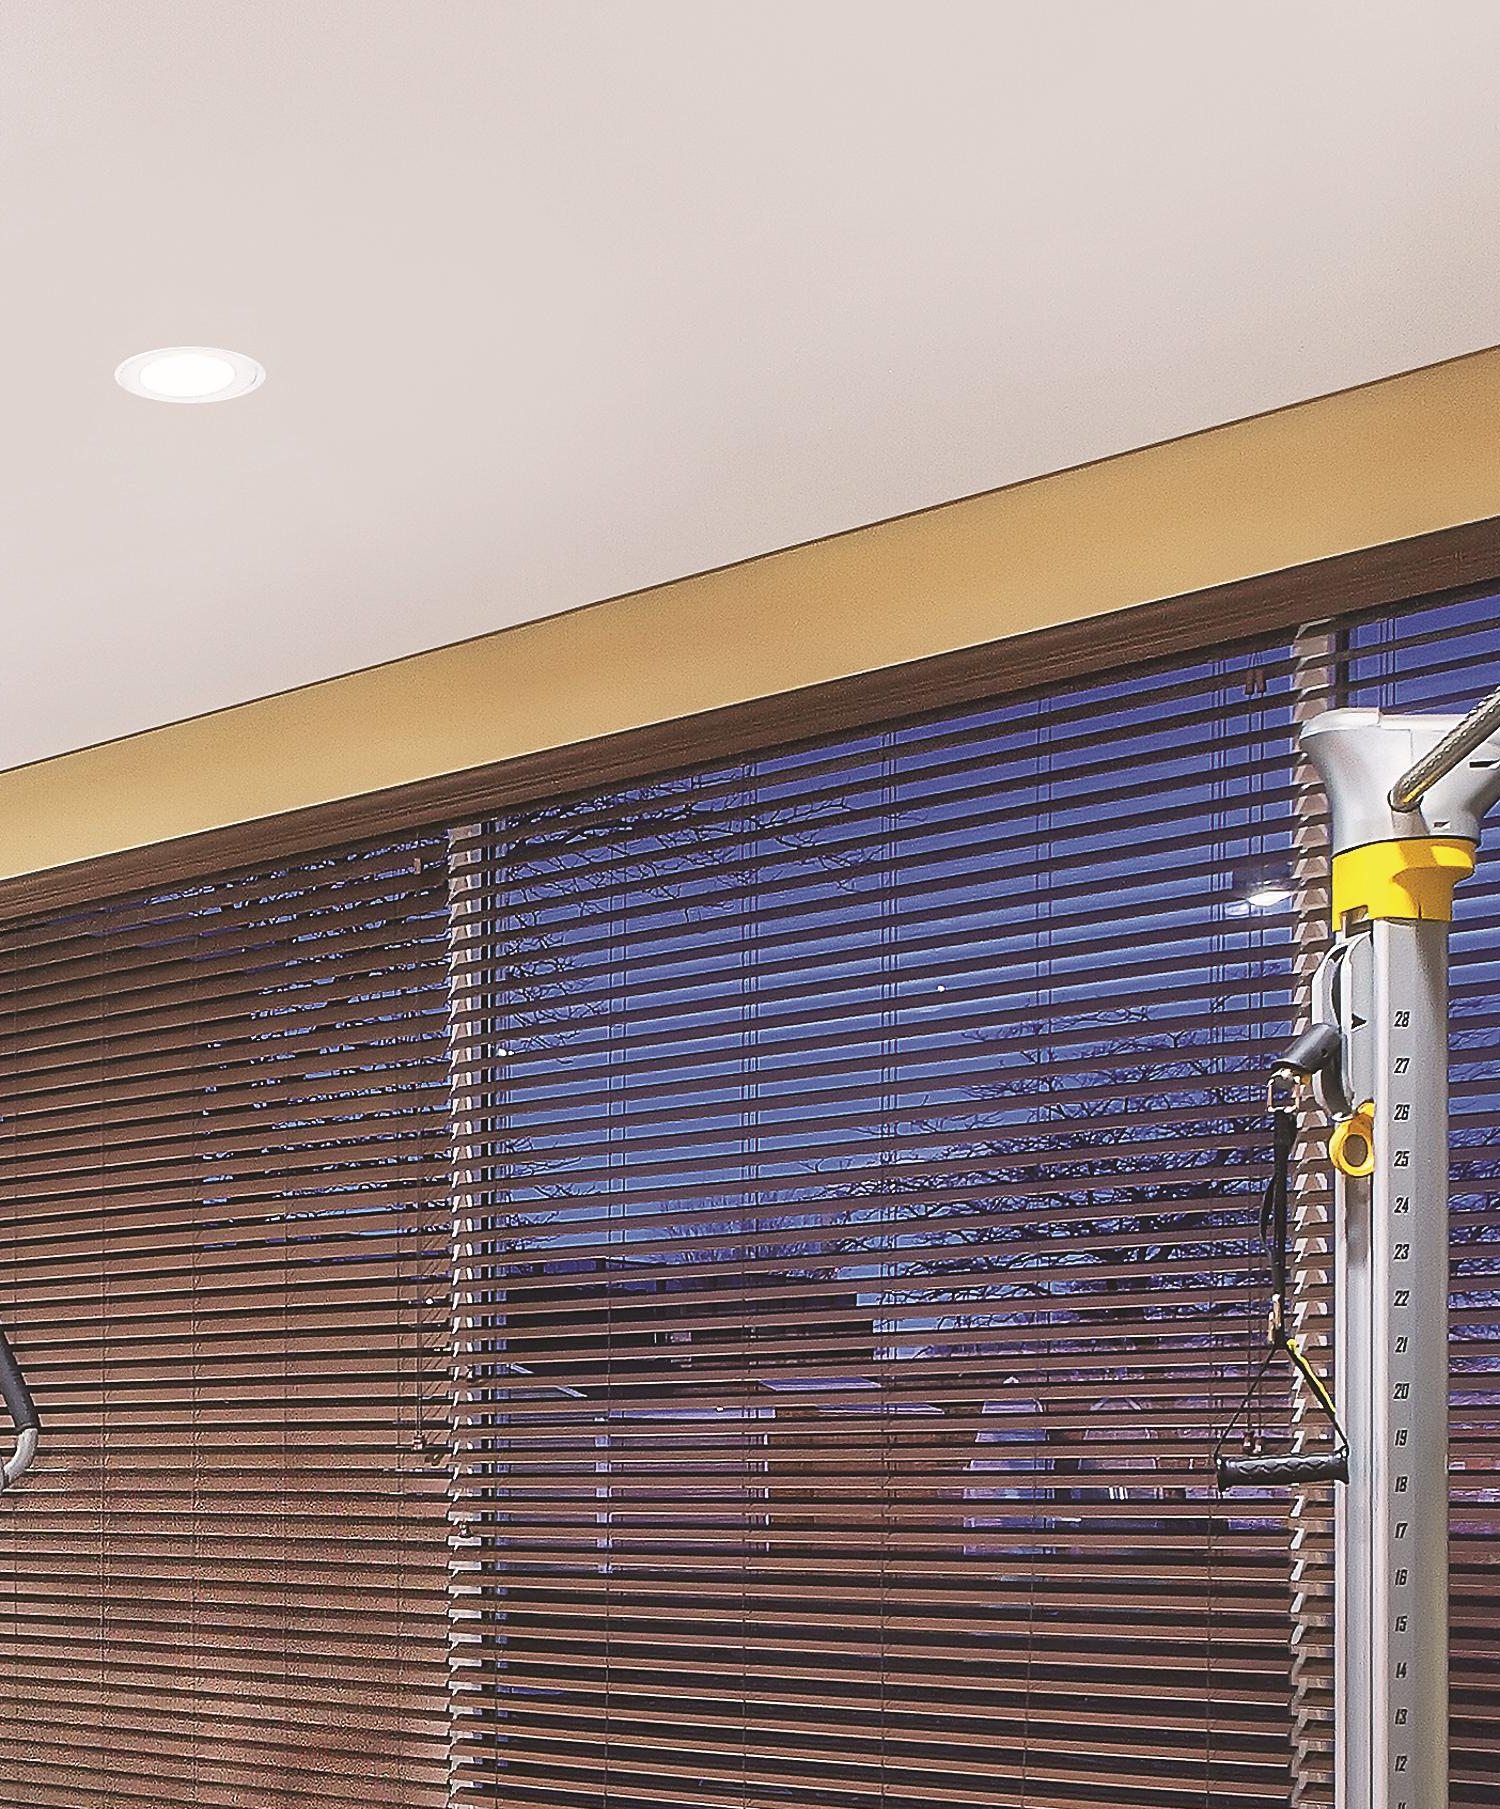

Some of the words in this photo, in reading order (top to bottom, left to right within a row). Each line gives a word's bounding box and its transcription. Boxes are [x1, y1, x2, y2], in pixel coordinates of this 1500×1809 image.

[1393, 1010, 1411, 1028] 28
[1393, 1057, 1411, 1074] 27
[1393, 1103, 1411, 1121] 26
[1393, 1150, 1410, 1167] 25
[1393, 1196, 1410, 1214] 24
[1393, 1242, 1410, 1260] 23
[1393, 1288, 1410, 1306] 22
[1394, 1335, 1409, 1353] 21
[1393, 1381, 1410, 1399] 20
[1393, 1429, 1409, 1448] 19
[1394, 1475, 1409, 1494] 18
[1394, 1522, 1409, 1539] 17
[1393, 1568, 1408, 1587] 16
[1394, 1615, 1408, 1632] 15
[1395, 1662, 1409, 1680] 14
[1394, 1708, 1408, 1725] 13
[1394, 1755, 1408, 1772] 12
